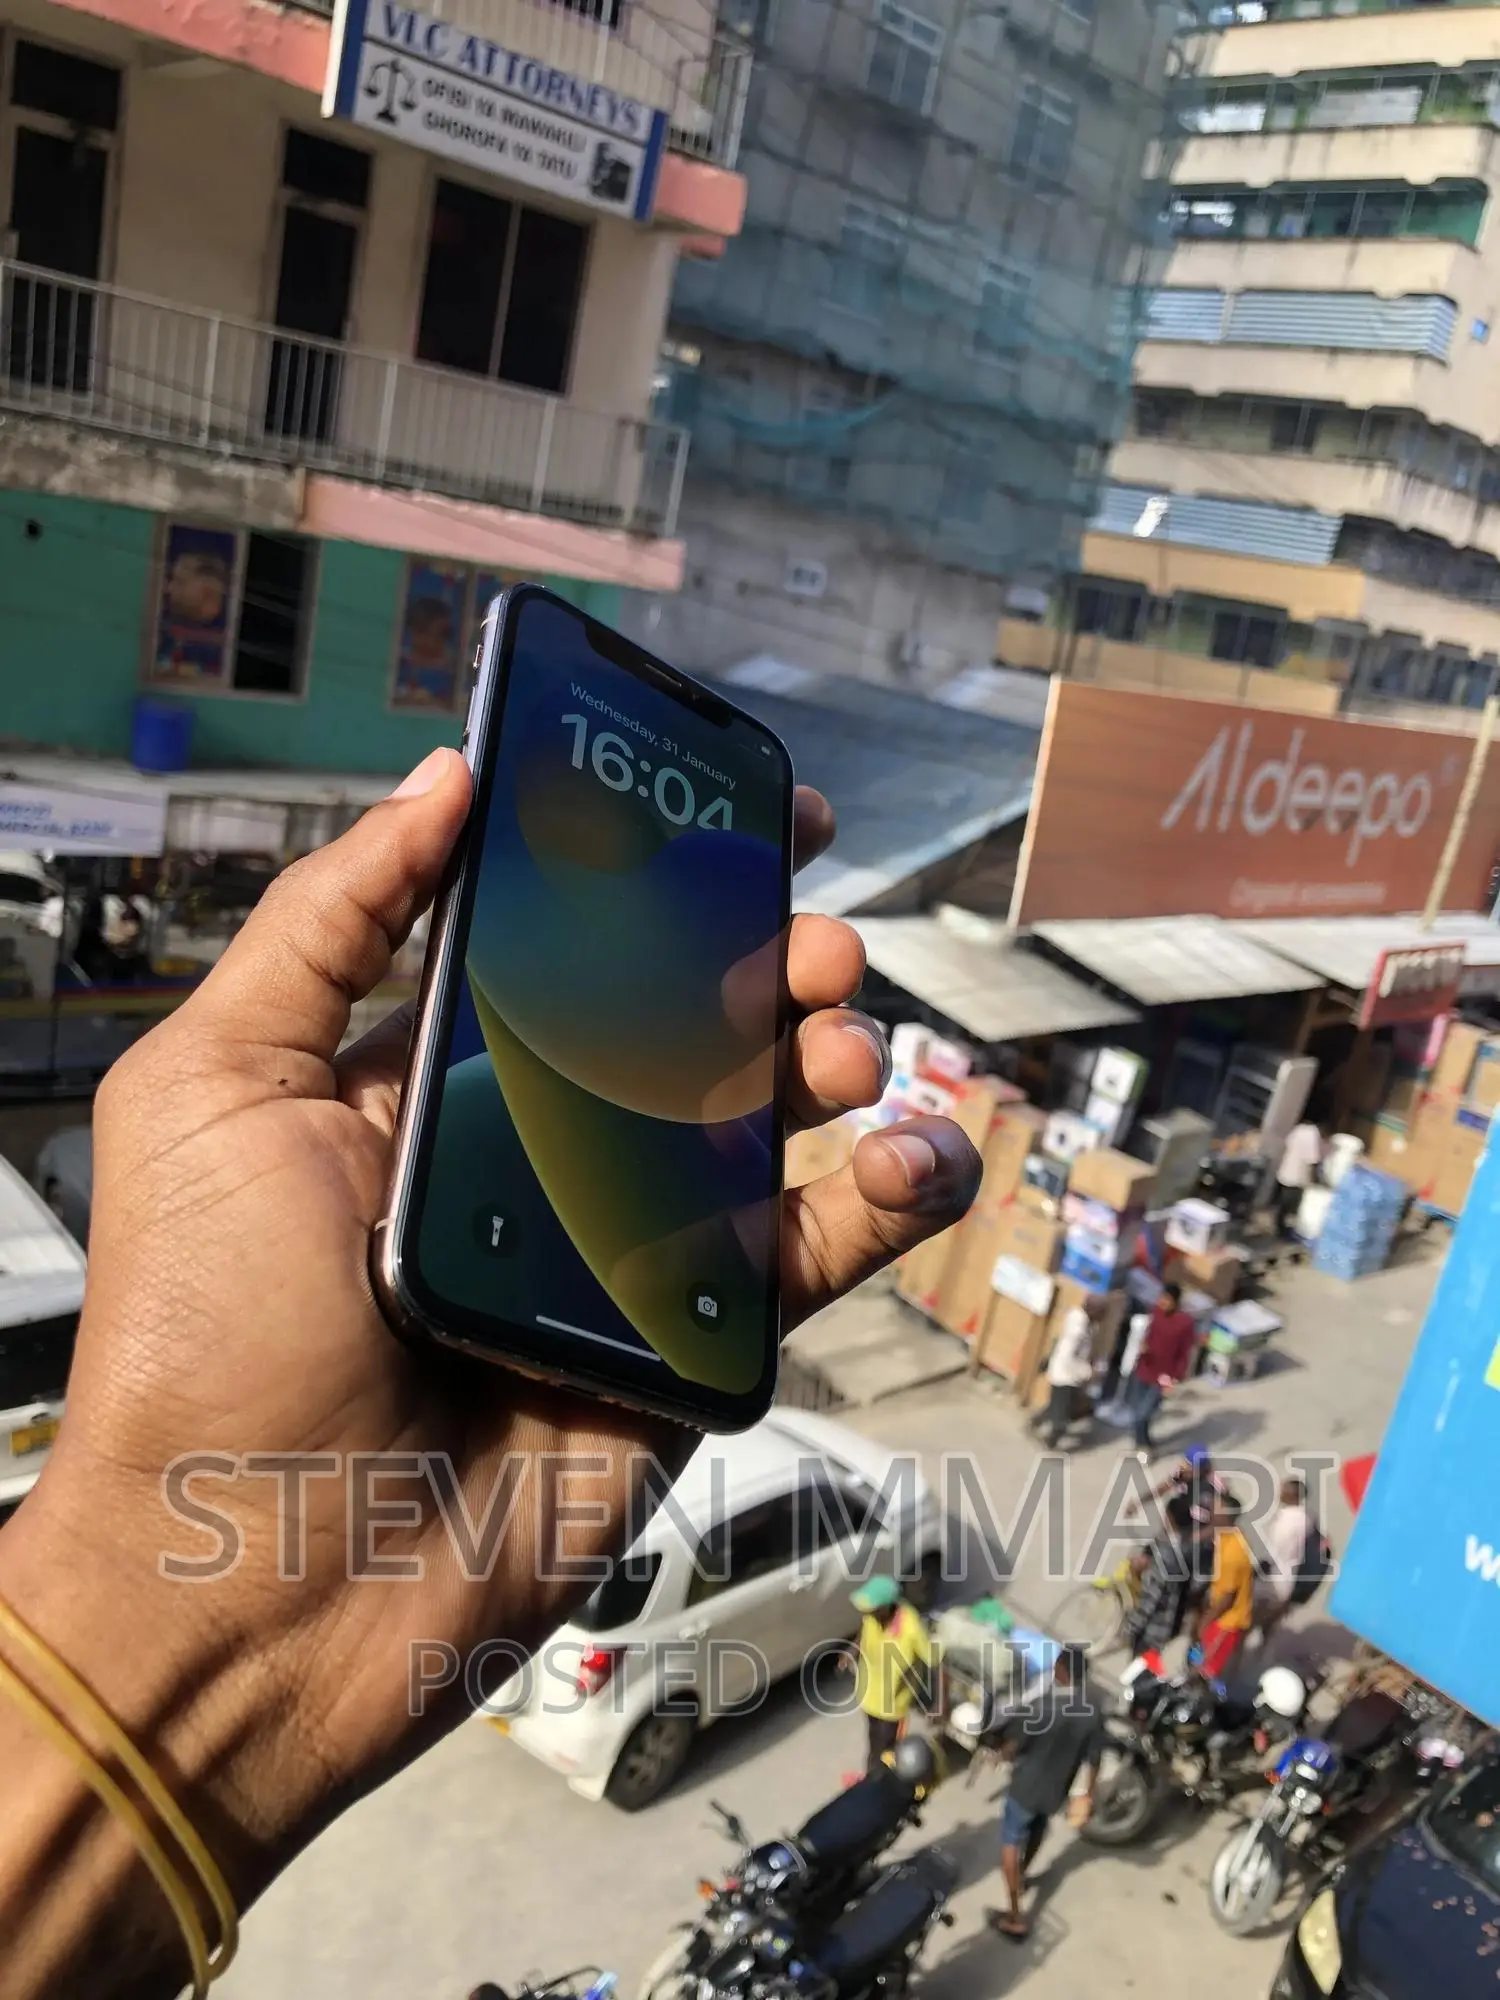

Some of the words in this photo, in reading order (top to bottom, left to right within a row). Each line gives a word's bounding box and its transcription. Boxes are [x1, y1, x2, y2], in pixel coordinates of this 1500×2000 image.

[457, 34, 641, 134] ATTORNEYS
[561, 713, 734, 832] 16:04
[570, 680, 659, 747] Wednesday,
[662, 735, 679, 756] 31
[681, 750, 737, 790] January
[1160, 718, 1432, 868] Aldeepo
